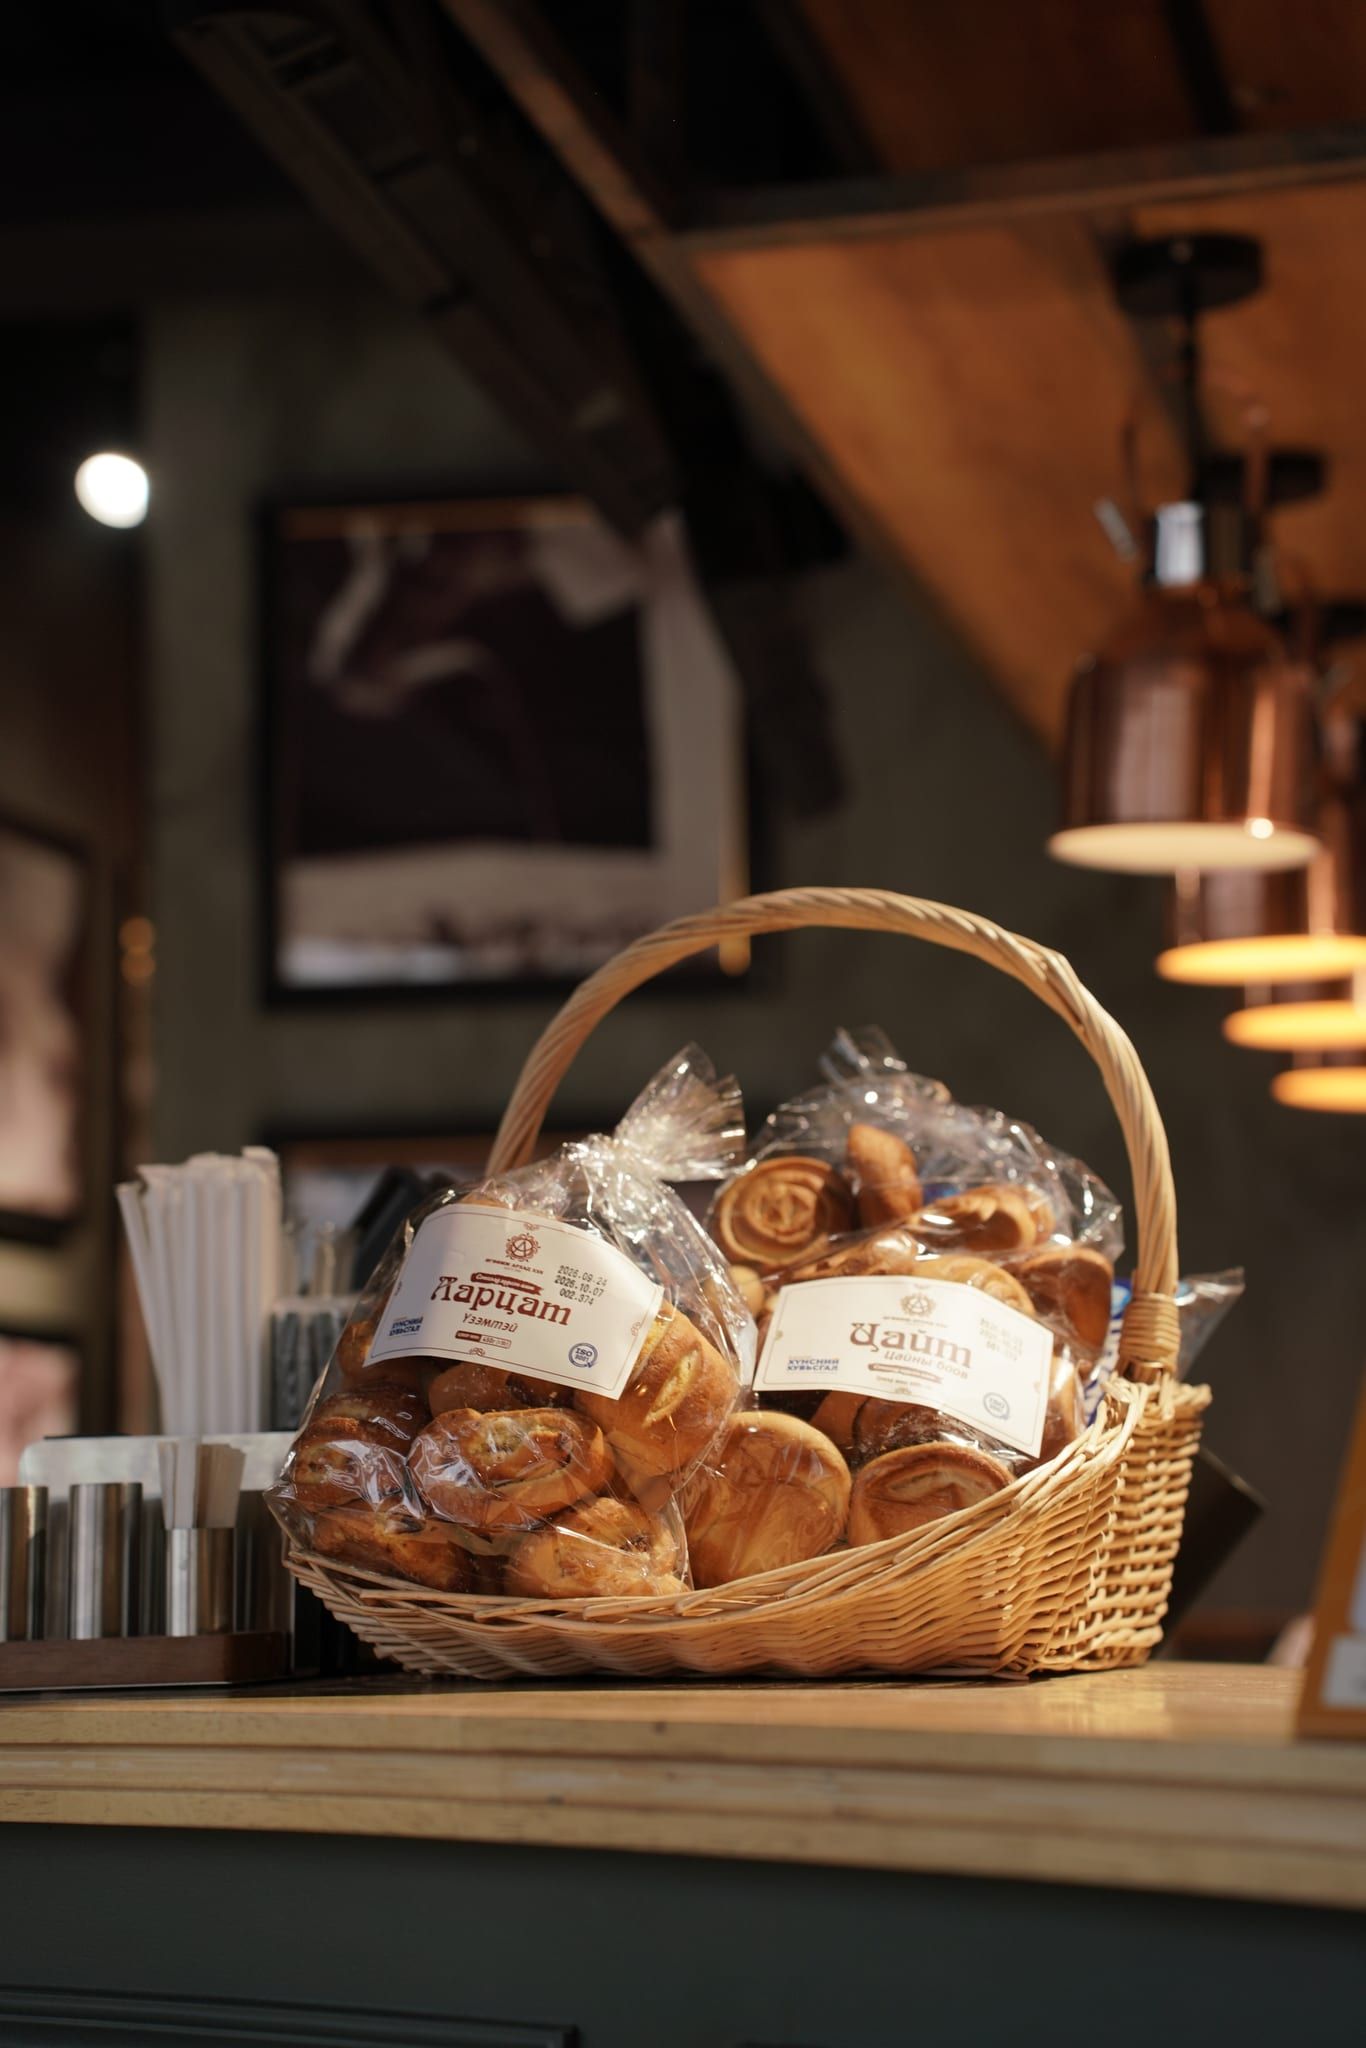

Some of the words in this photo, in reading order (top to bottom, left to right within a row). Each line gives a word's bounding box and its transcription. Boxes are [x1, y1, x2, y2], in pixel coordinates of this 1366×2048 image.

[431, 1276, 572, 1326] Аарцат
[575, 1348, 593, 1358] ISO
[849, 1322, 972, 1369] Цайт
